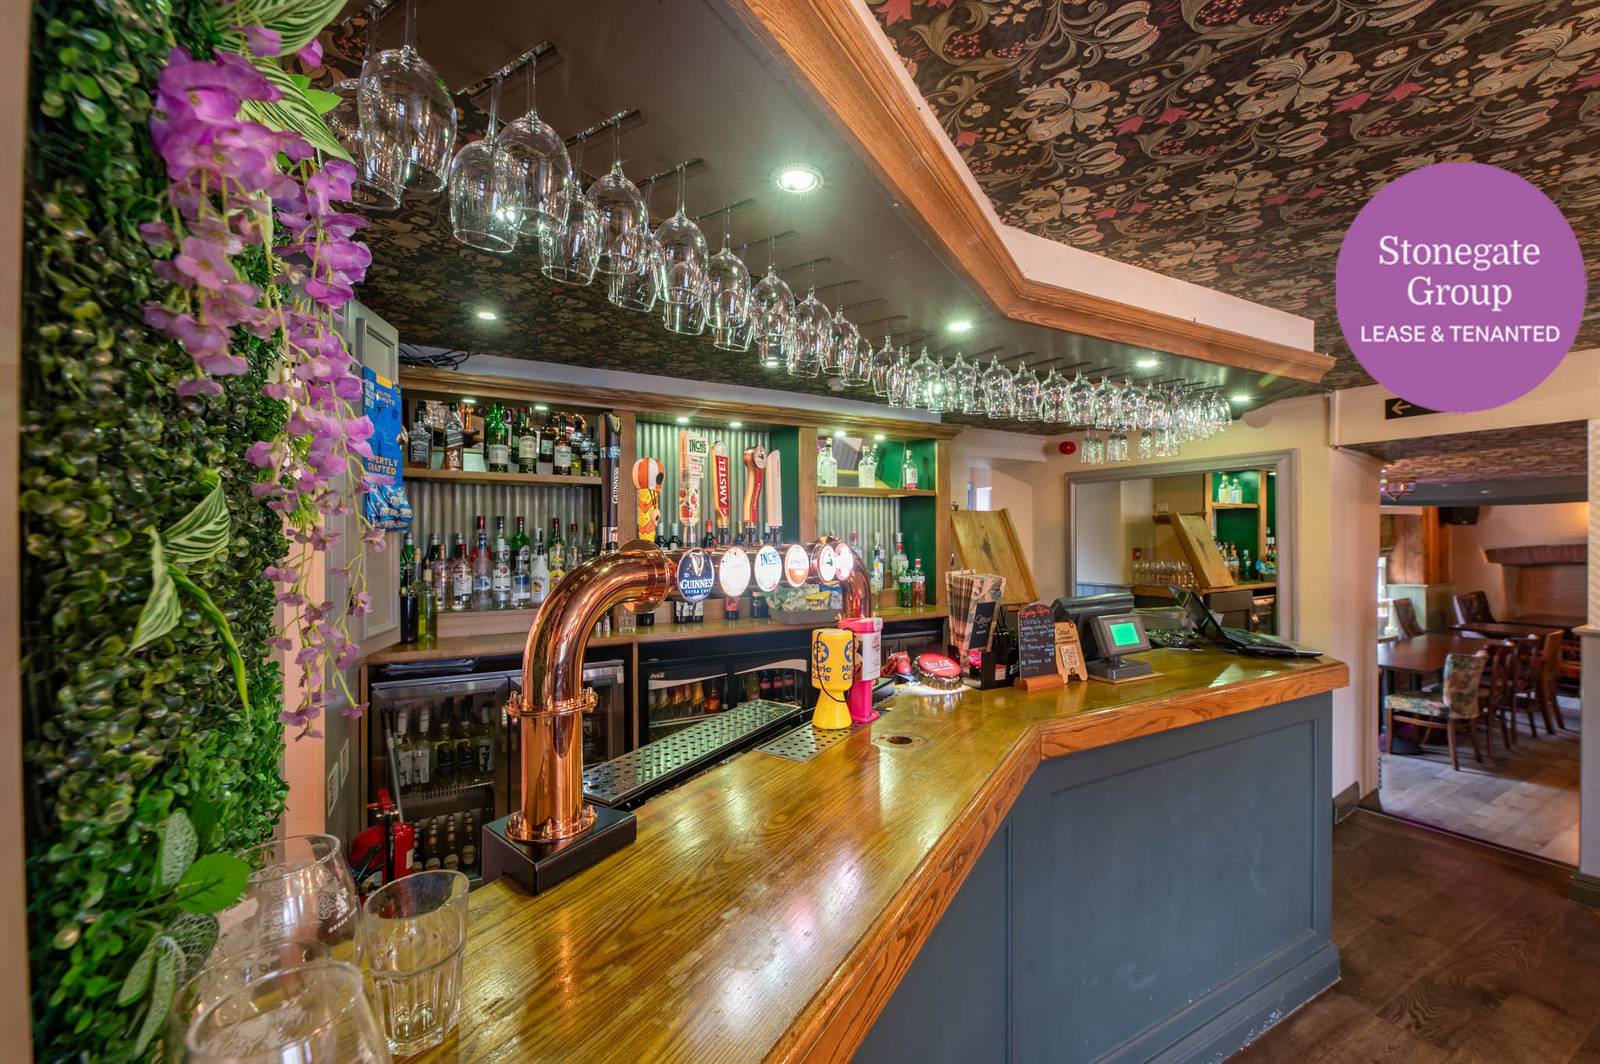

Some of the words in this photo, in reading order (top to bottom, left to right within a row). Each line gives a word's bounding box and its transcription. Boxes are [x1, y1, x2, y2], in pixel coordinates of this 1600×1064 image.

[368, 462, 396, 475] CRAFTED
[718, 460, 727, 504] AMSTEL
[813, 664, 832, 672] Mrie
[813, 672, 831, 681] Crie
